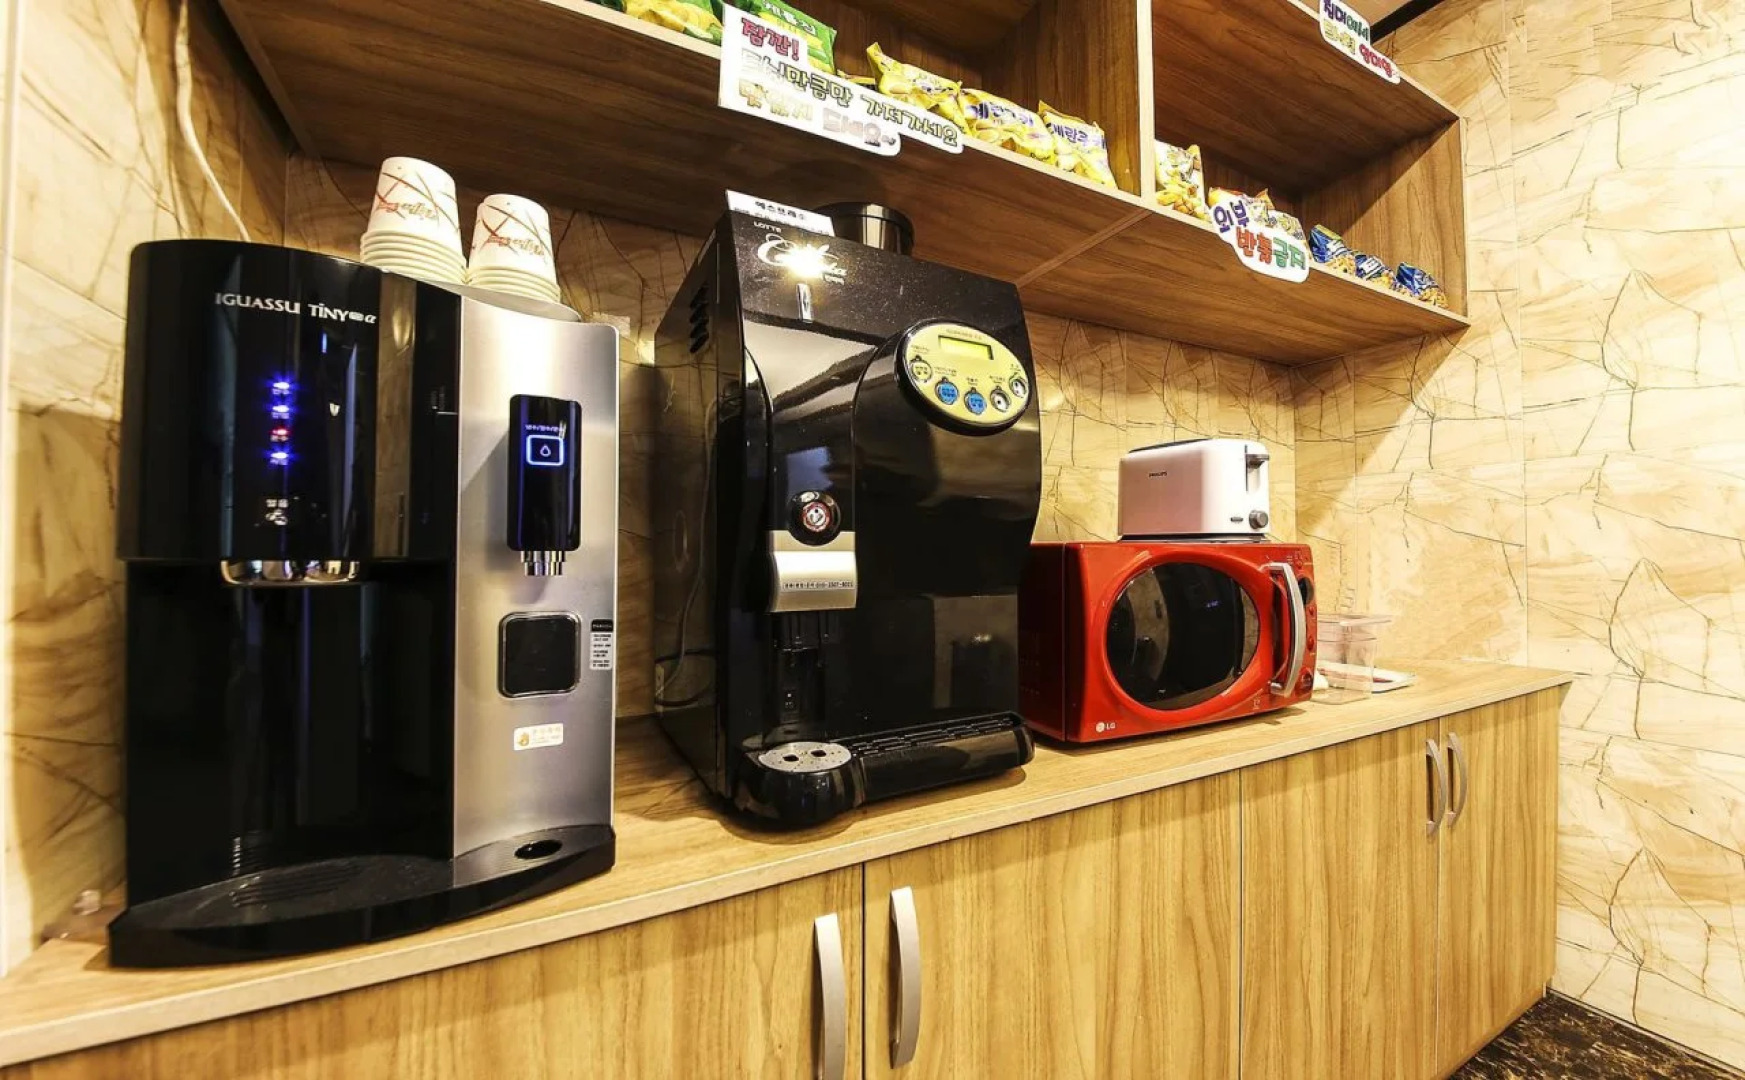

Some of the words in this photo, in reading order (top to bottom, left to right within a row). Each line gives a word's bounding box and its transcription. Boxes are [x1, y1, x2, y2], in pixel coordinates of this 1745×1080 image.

[741, 17, 800, 62] 잠깐!
[860, 93, 959, 147] 가져가세요
[1213, 200, 1249, 234] 외부
[1236, 226, 1306, 270] 반출금지
[214, 292, 301, 315] IGUASSU
